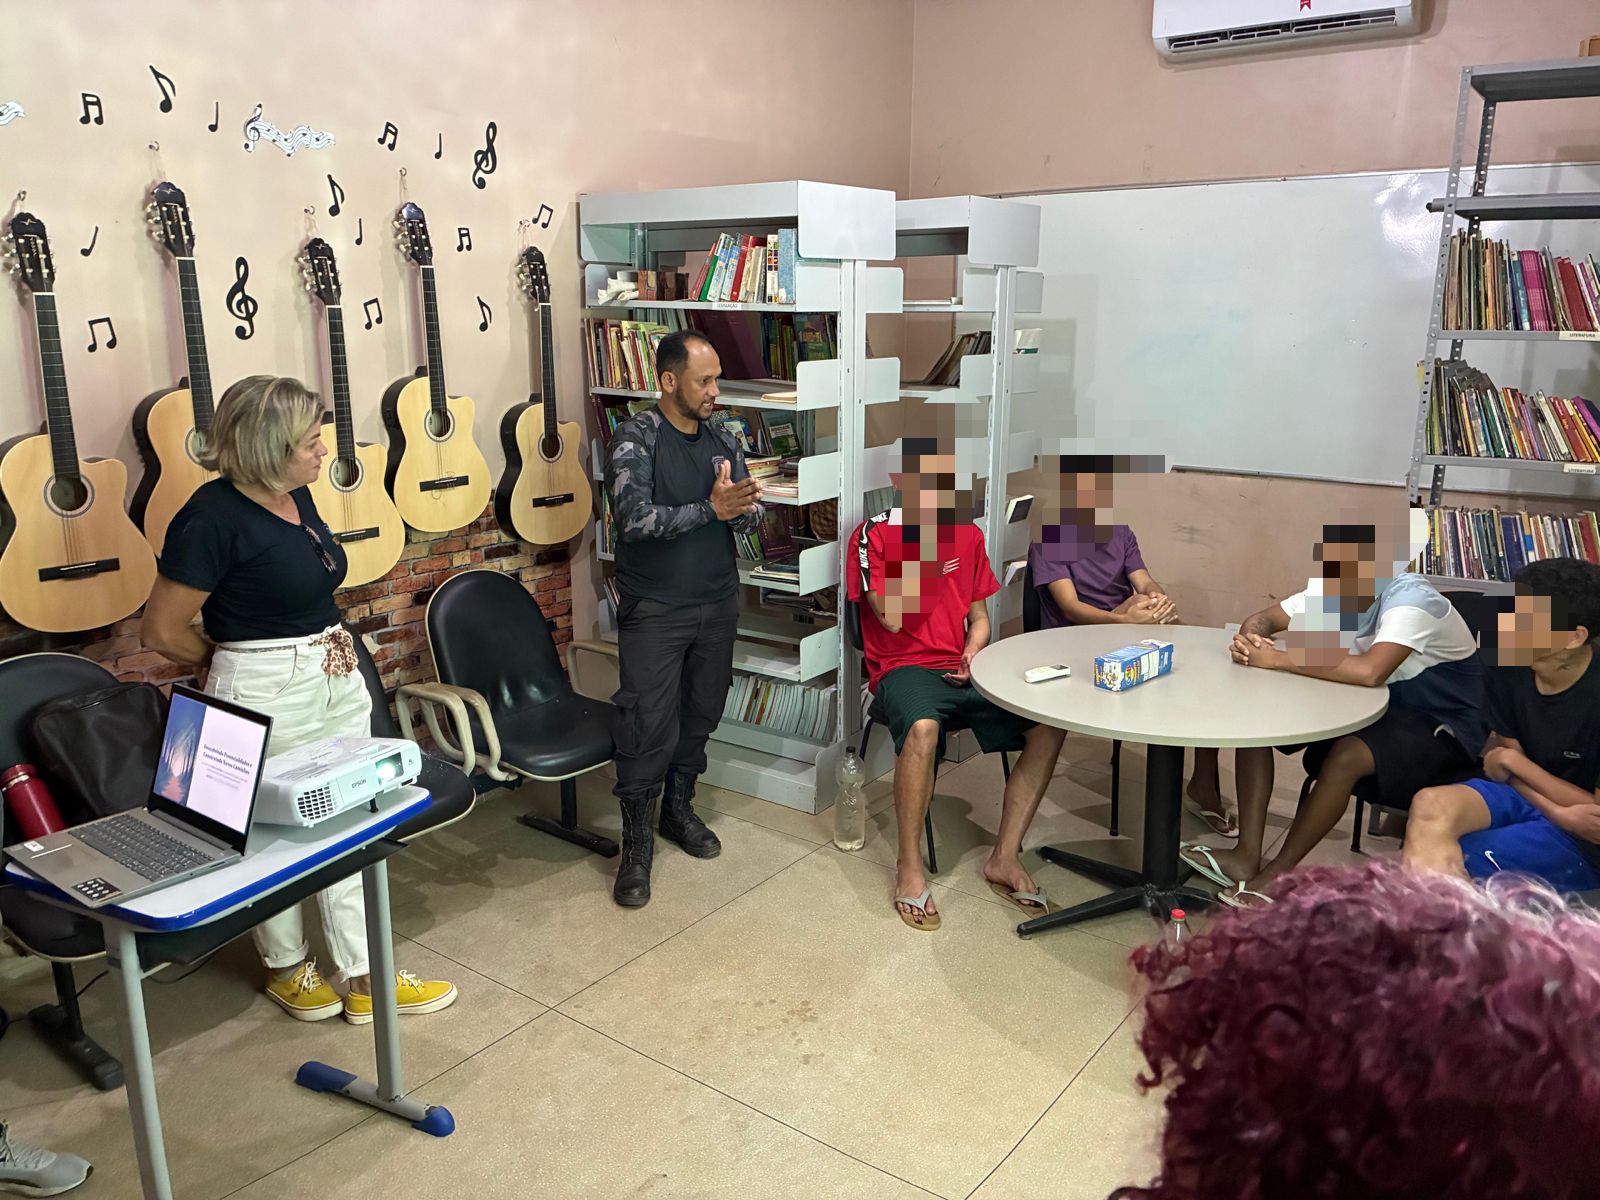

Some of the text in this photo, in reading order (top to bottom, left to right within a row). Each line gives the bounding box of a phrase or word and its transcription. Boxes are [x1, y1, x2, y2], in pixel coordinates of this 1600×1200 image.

[870, 511, 889, 524] NIKE
[858, 546, 869, 569] NIKE
[352, 779, 367, 788] EPSON
